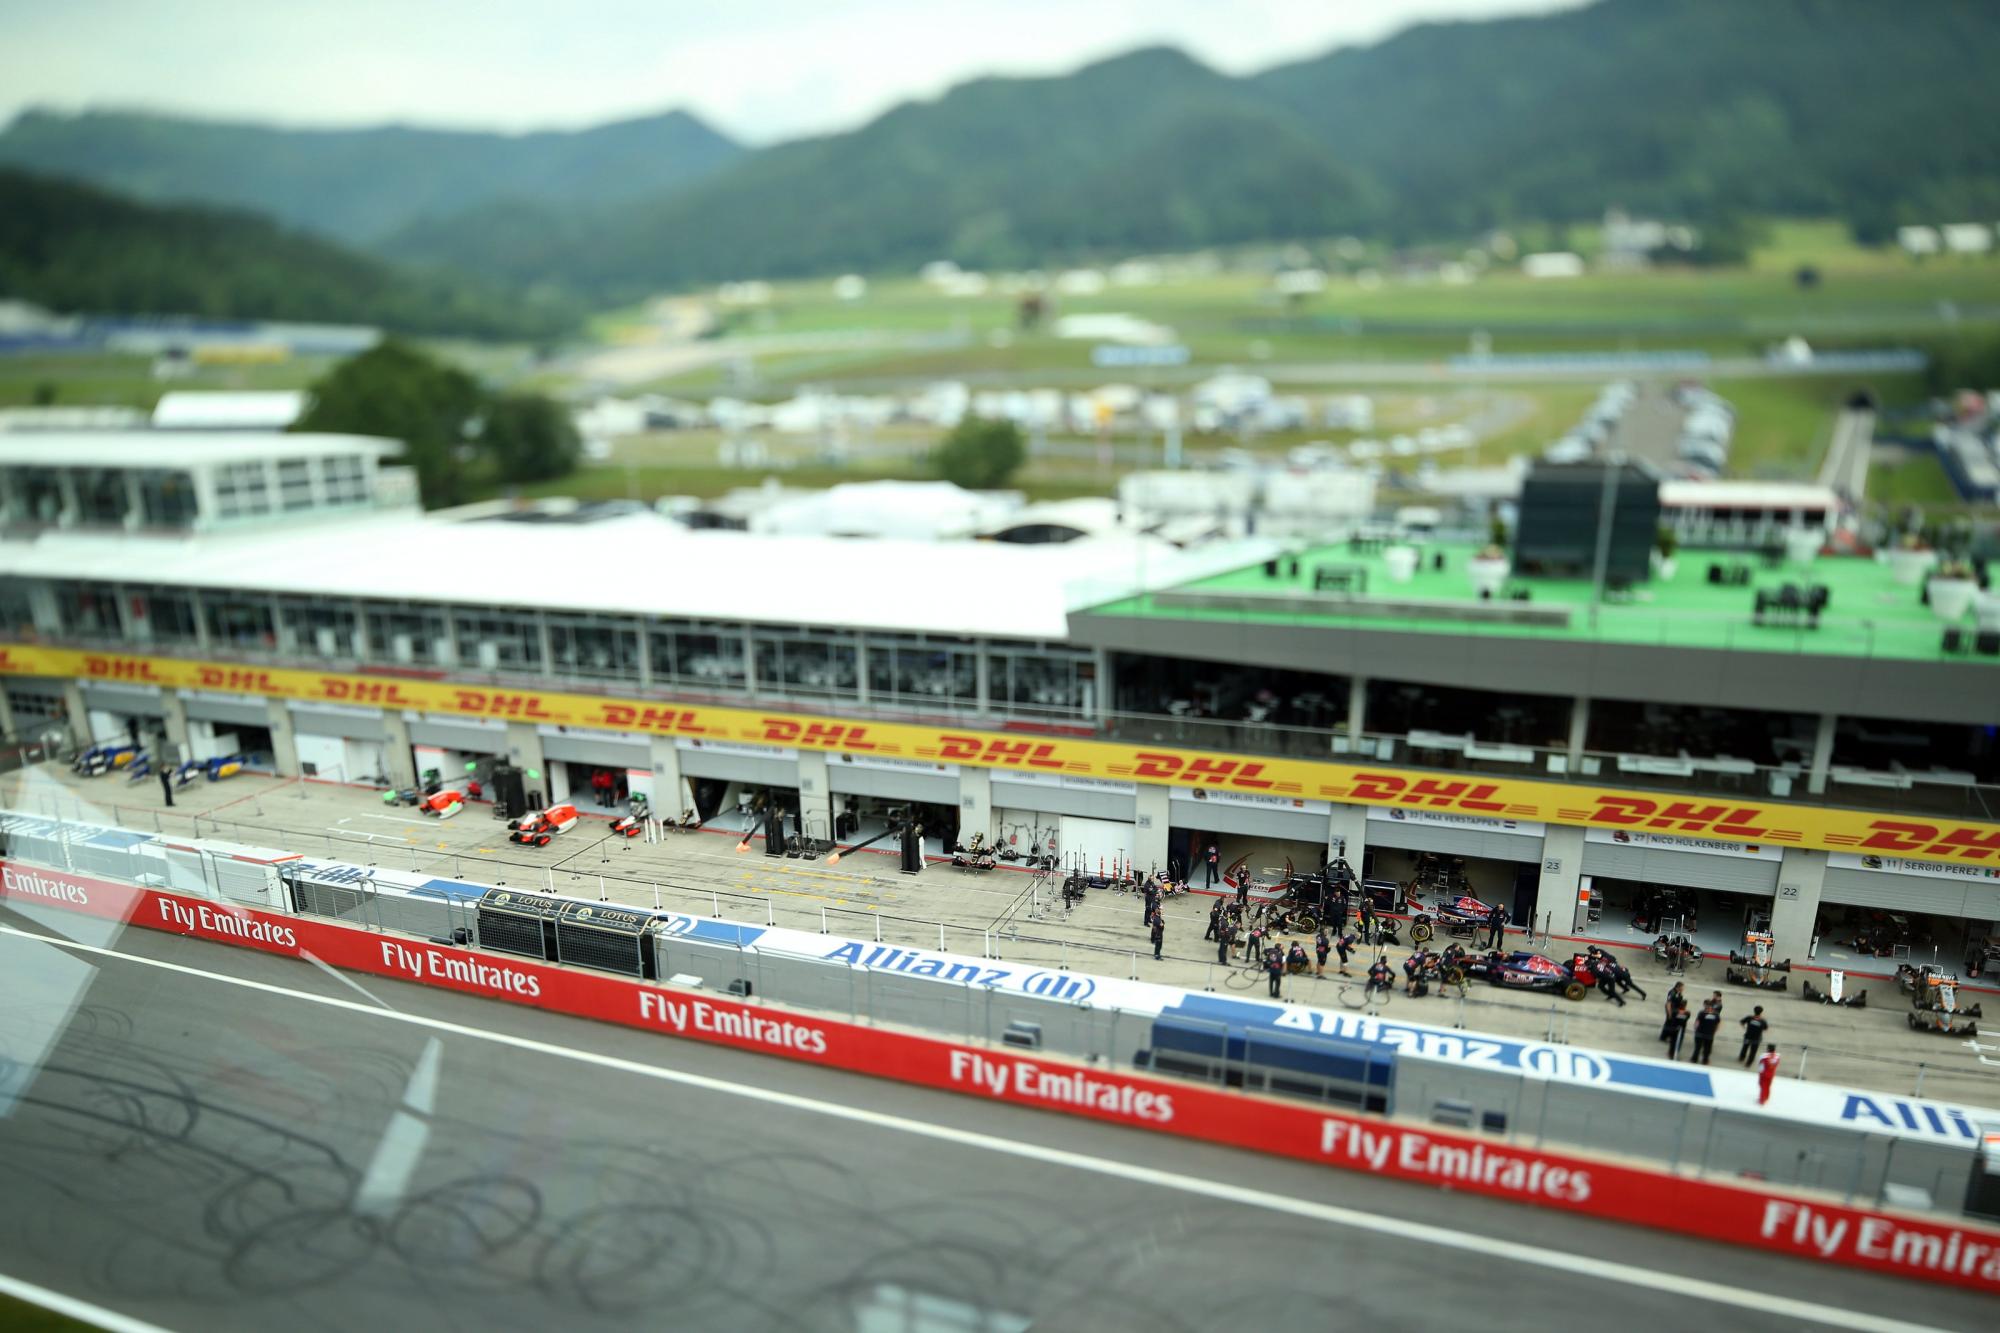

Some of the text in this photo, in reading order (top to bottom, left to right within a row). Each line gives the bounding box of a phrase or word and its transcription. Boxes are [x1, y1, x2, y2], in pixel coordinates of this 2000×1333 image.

[198, 667, 281, 692] DHL
[320, 678, 408, 704] DHL
[455, 690, 550, 718] DHL
[600, 704, 706, 733] DHL
[762, 719, 876, 750] DHL
[939, 736, 1064, 768] DHL
[1134, 753, 1274, 789] DHL
[1349, 773, 1506, 811] DHL
[1424, 812, 1441, 821] MAX
[1444, 813, 1500, 827] VERSTAPPEN
[1589, 796, 1767, 836] DHL
[1634, 833, 1646, 842] 27
[1651, 835, 1674, 845] NICO
[1859, 820, 2000, 859] DH
[1546, 861, 1560, 870] 23
[1887, 859, 1980, 876] 11 SERGIO PEREZ
[1, 867, 89, 905] Emirates
[518, 895, 553, 908] LOTUS
[1783, 887, 1797, 896] 22
[158, 897, 297, 948] Fly Emirates
[600, 910, 639, 923] LOTUS
[380, 941, 541, 997] Fly Emirates
[824, 942, 1011, 987] Allianz
[638, 991, 827, 1053] Fly Emirates
[1274, 1005, 1503, 1066] Allianz
[950, 1050, 1174, 1121] Fly Emirates
[1321, 1119, 1592, 1201] Fly Emirates
[1760, 1200, 1848, 1256] Fly
